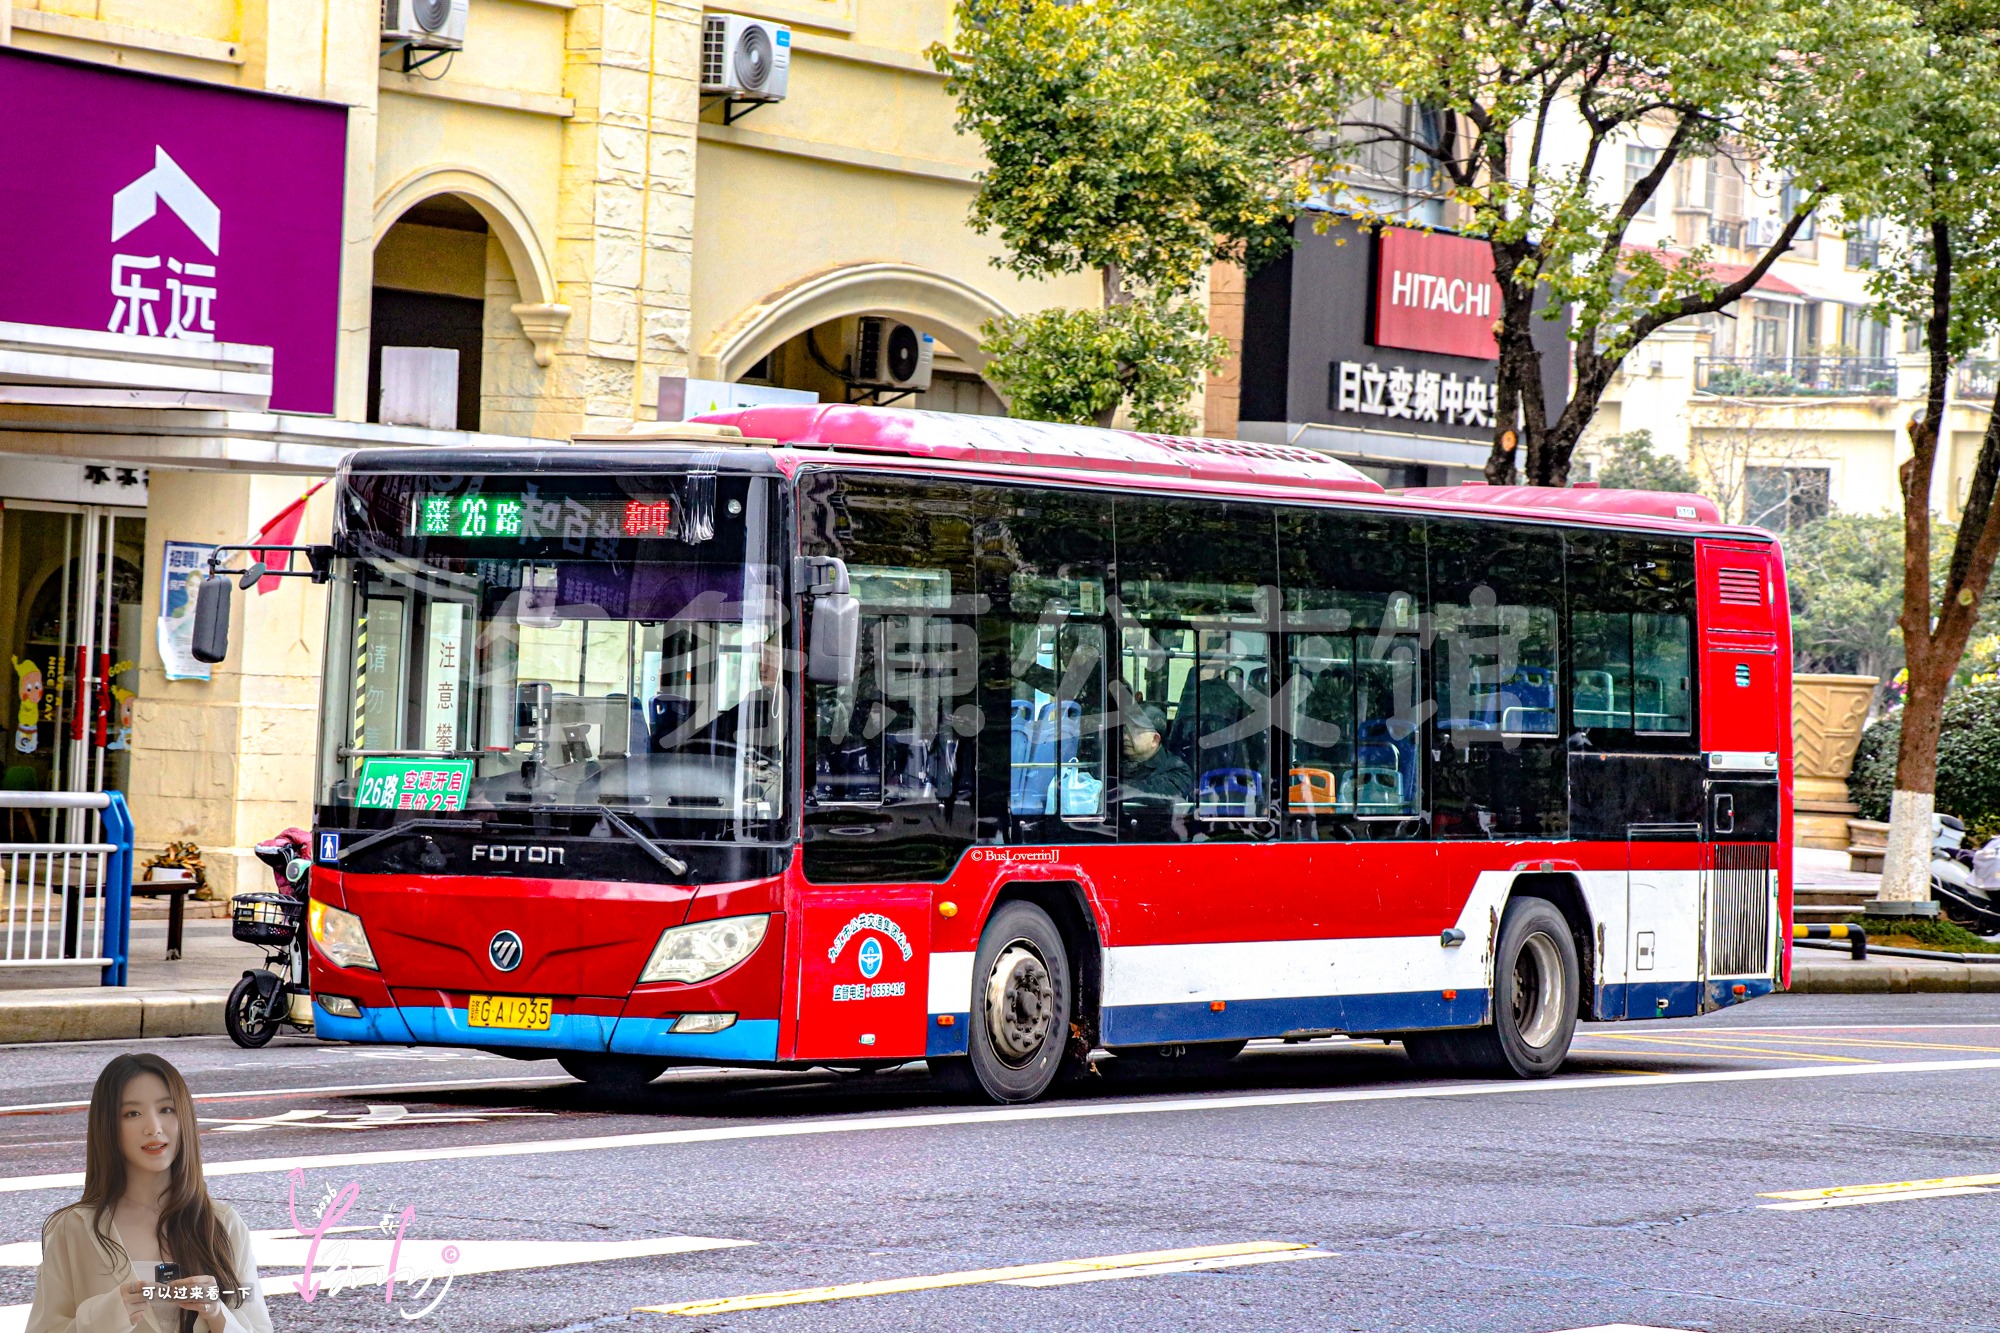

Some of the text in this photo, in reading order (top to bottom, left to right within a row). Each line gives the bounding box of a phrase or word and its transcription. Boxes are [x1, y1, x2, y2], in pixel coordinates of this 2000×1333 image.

[107, 253, 217, 342] 乐远
[1392, 270, 1491, 317] HITACHI
[1338, 361, 1526, 431] 日立变频中央
[461, 498, 488, 536] 26
[44, 656, 57, 721] NICE DAY
[361, 770, 463, 808] 26路 空调开启
[398, 792, 460, 810] 票价2元
[471, 845, 566, 866] FOTON
[828, 913, 913, 963] 九江市公共交通集团公司
